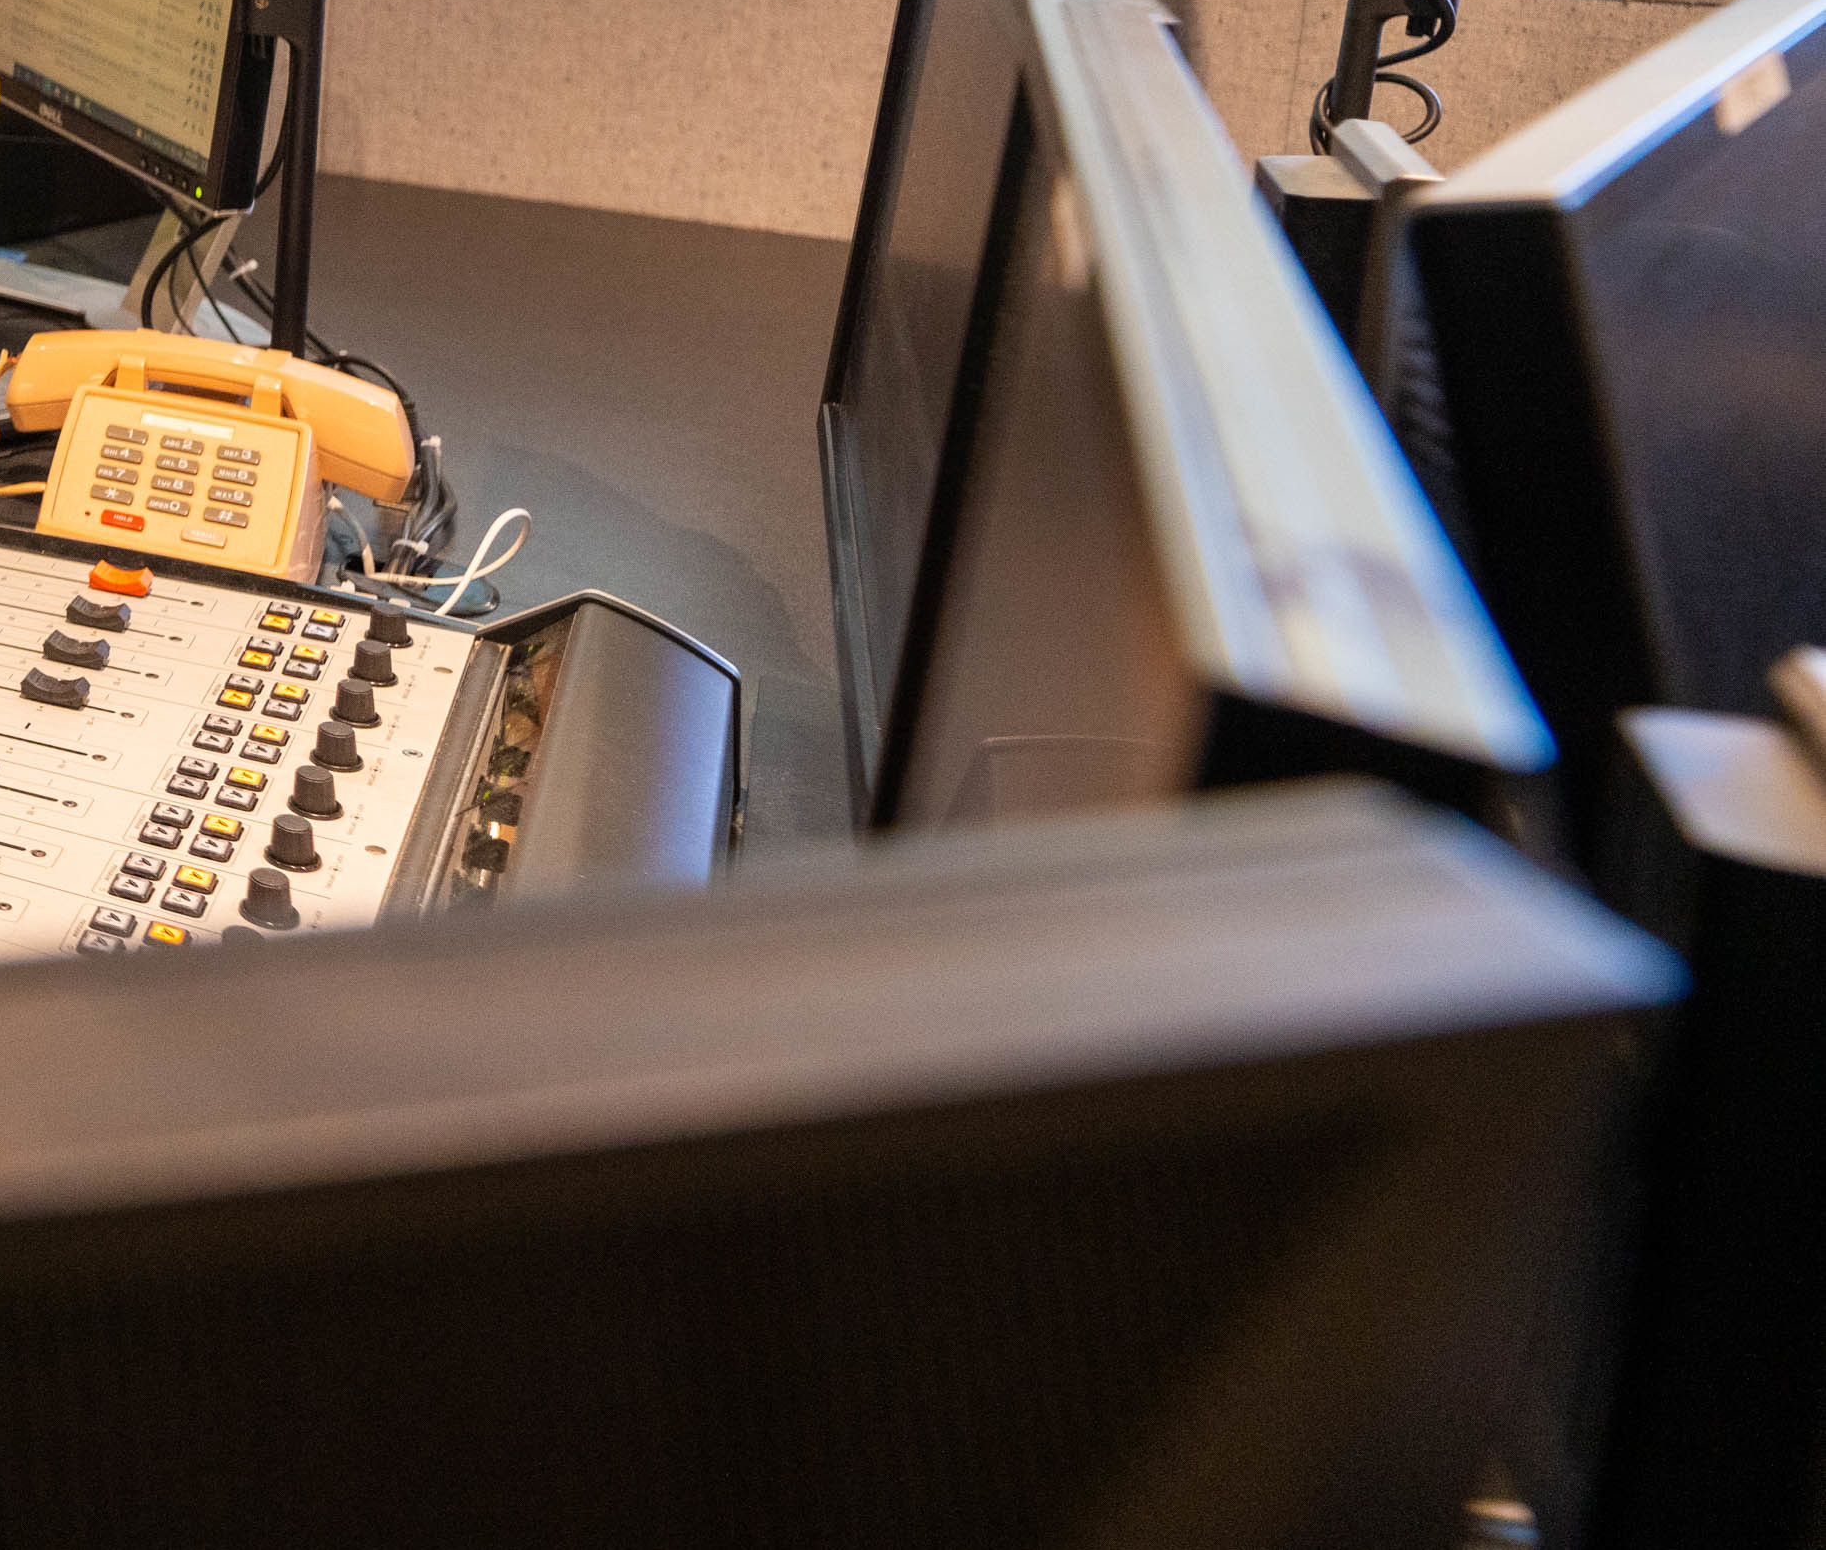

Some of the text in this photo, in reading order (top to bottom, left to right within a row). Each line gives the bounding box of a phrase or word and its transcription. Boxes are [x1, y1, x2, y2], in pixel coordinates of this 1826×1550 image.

[127, 429, 135, 439] 1
[182, 438, 194, 450] 2
[119, 449, 130, 458] 4
[116, 468, 126, 478] 7
